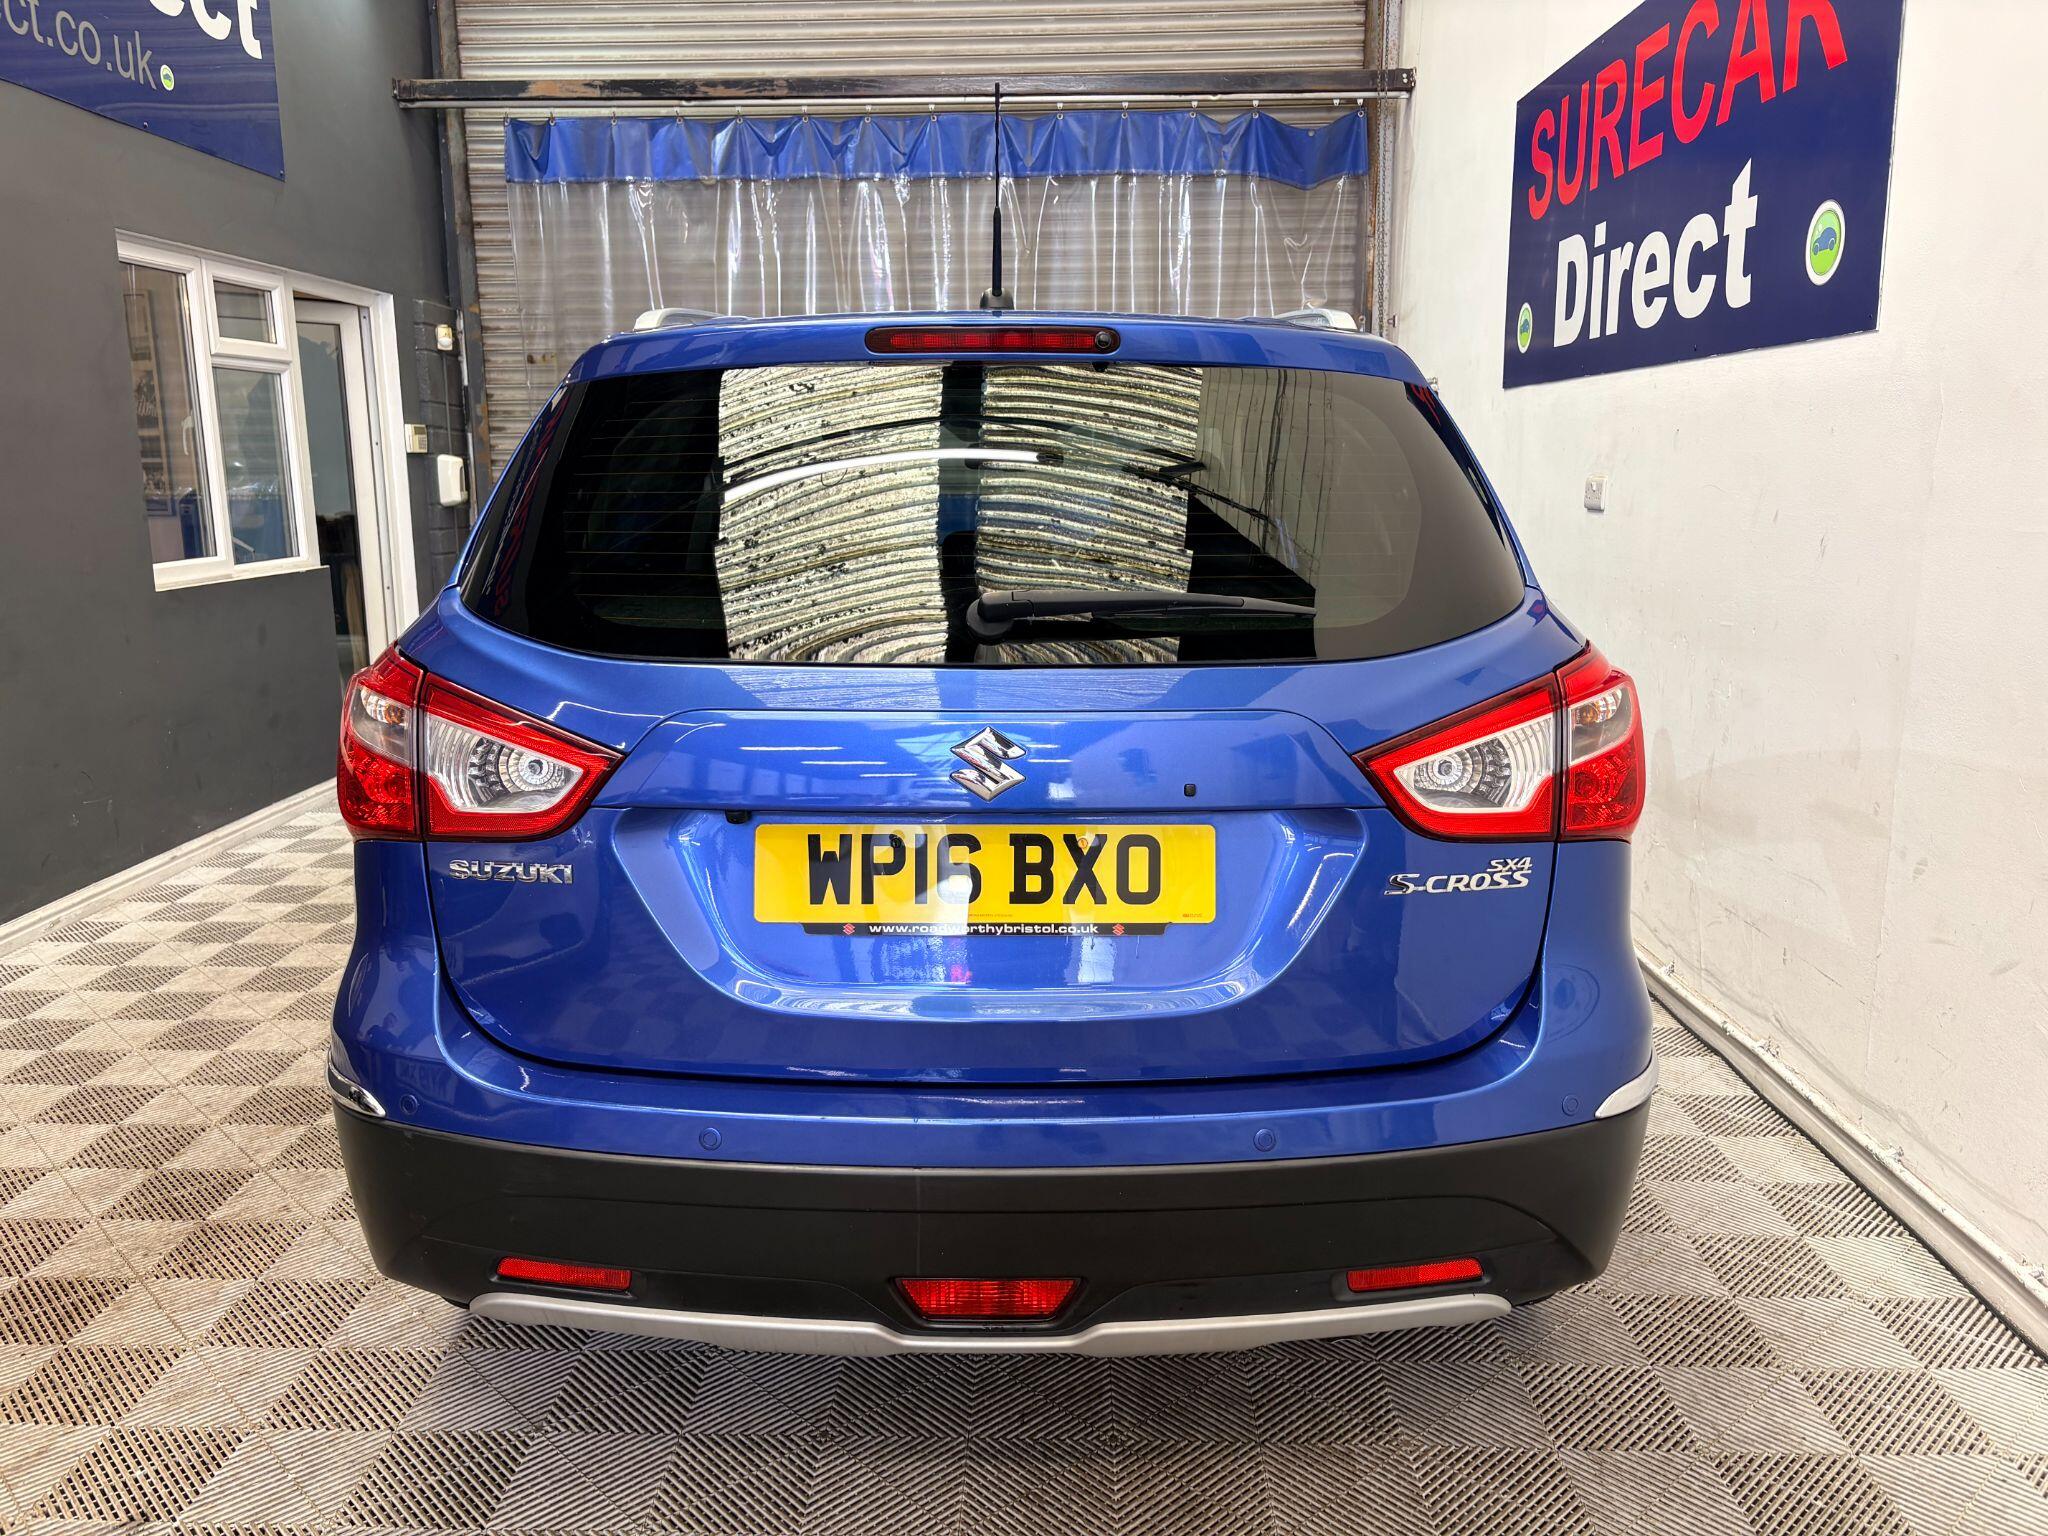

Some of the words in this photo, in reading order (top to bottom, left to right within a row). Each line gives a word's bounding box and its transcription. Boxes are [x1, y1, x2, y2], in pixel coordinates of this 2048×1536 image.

[0, 0, 157, 90] ct.co.uk
[151, 0, 263, 59] ct
[1553, 157, 1758, 347] Direct
[450, 859, 573, 884] SUZUKI
[808, 833, 981, 904] WP16
[1009, 833, 1161, 904] BXO
[1384, 870, 1532, 895] S-CROSS
[1487, 857, 1532, 872] SX4
[869, 923, 1098, 936] www.roadworthybristol.co.uk
